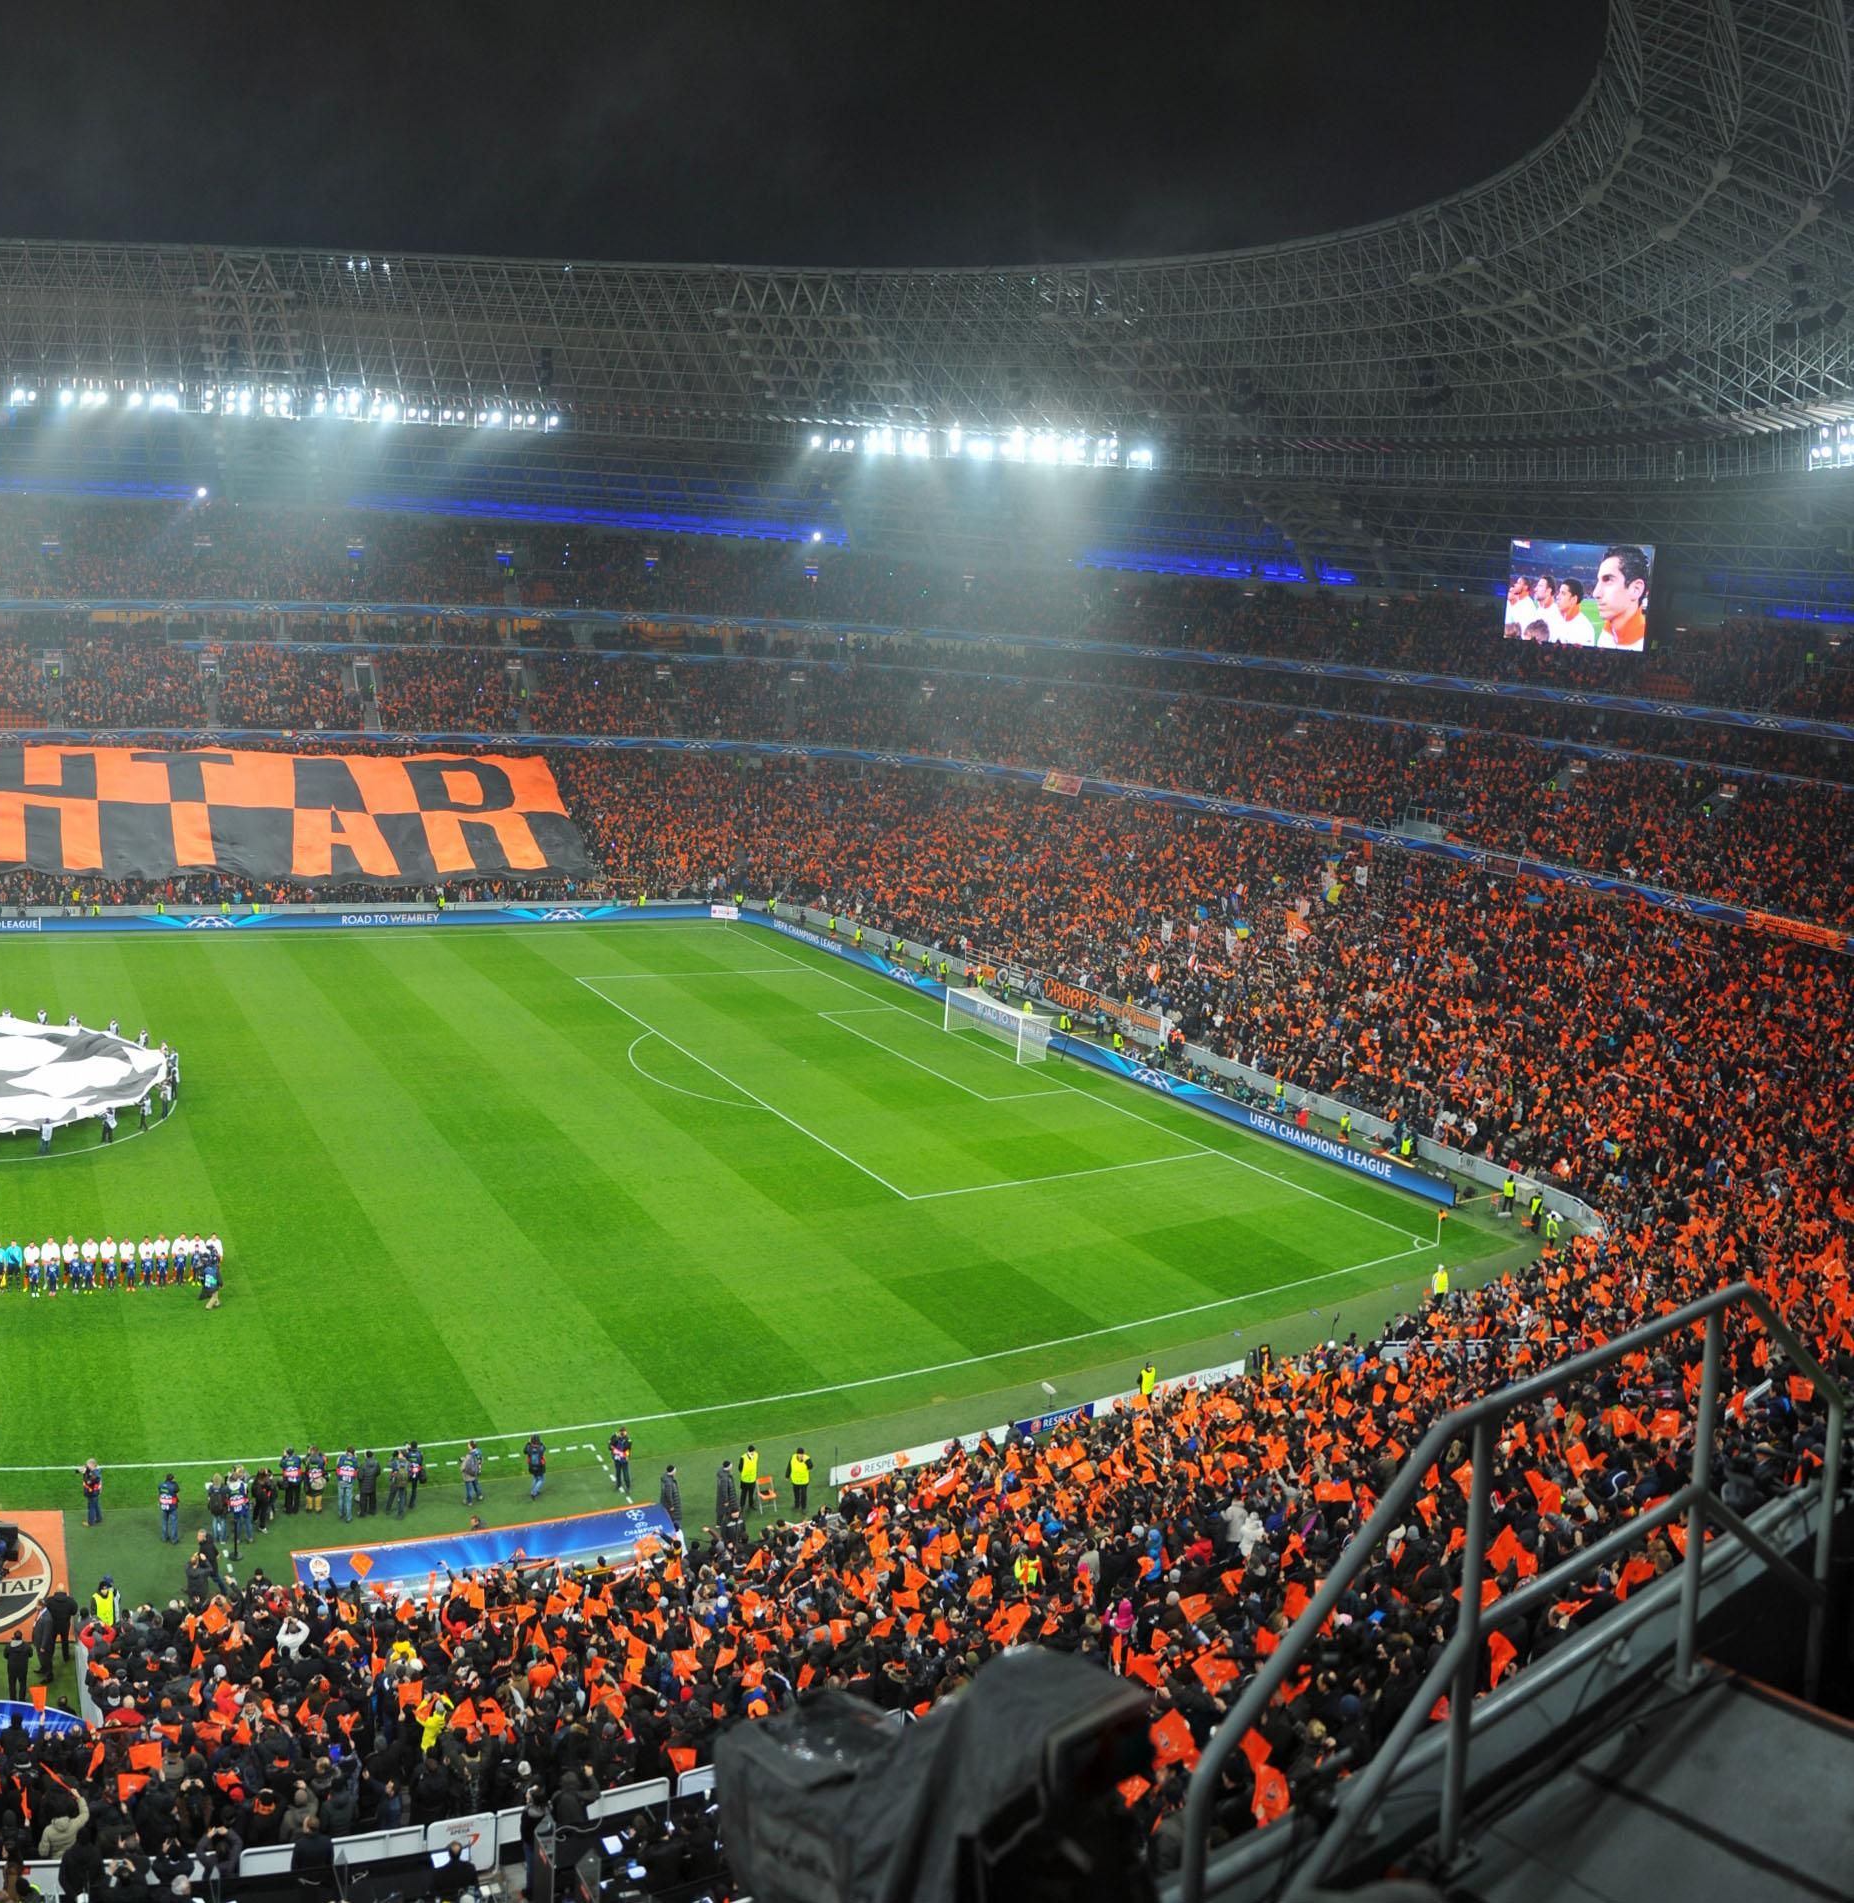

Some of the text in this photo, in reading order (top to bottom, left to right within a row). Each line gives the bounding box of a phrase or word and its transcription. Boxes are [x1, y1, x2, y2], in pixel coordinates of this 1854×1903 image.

[1, 920, 38, 928] LEAGUE
[341, 913, 440, 925] ROAD TO WEMBLEY
[773, 918, 842, 953] UEFA CHAMPIONS LEAGUE
[1249, 1112, 1392, 1178] UEFA CHAMPIONS LEAGUE
